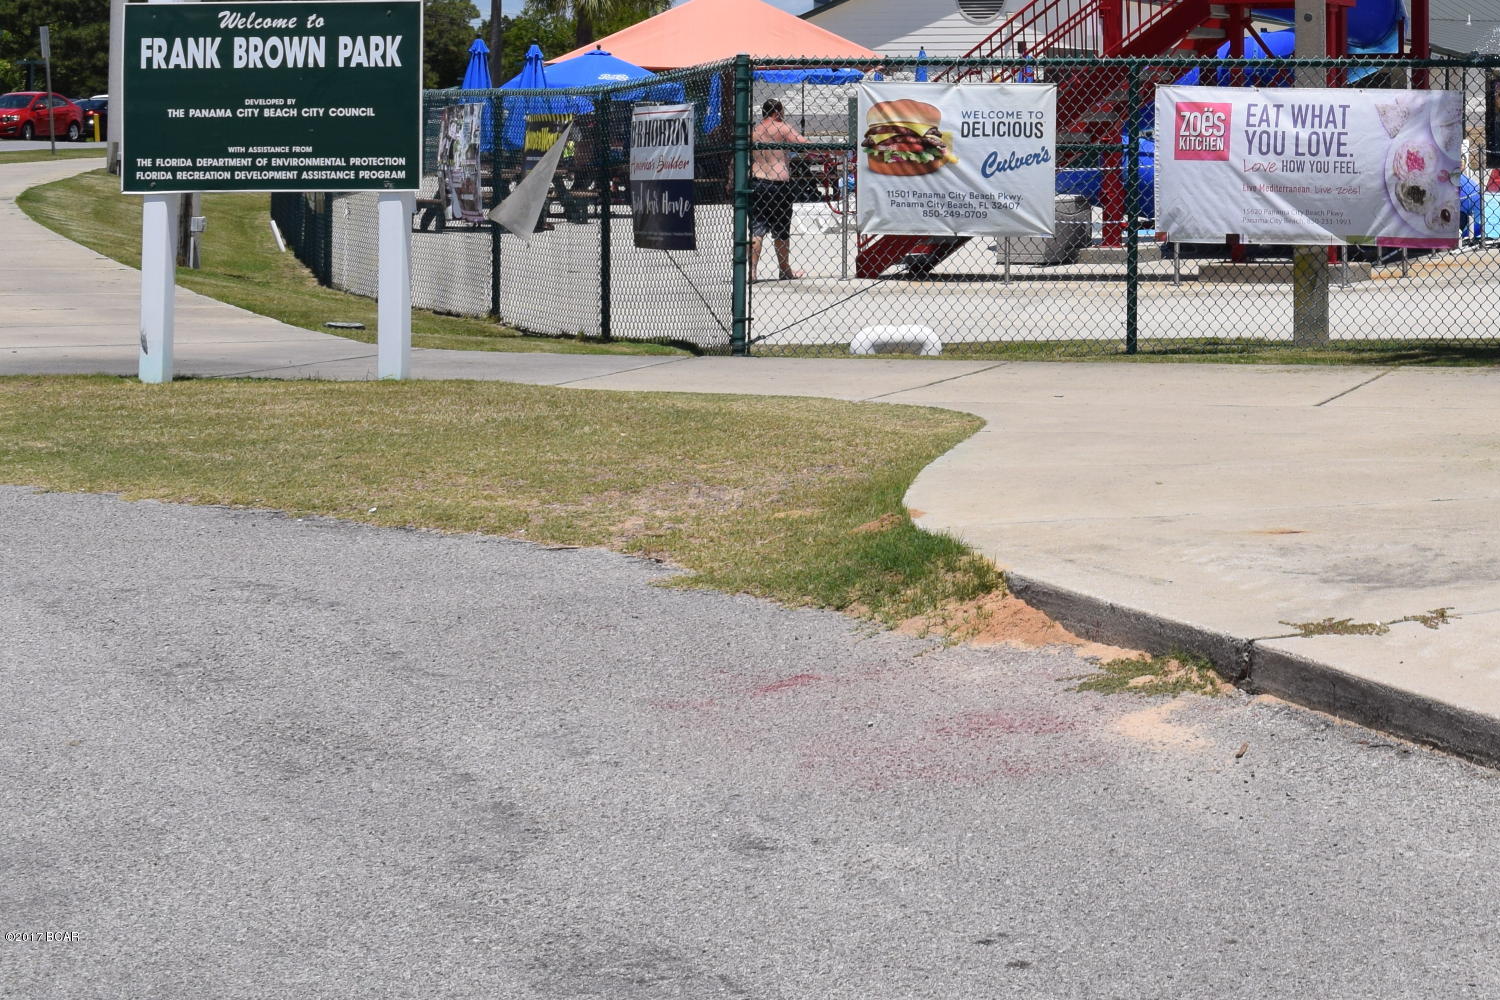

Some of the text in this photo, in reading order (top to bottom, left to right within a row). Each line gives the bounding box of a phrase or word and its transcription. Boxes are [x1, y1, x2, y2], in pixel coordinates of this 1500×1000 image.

[218, 10, 325, 29] Welcome to
[140, 35, 403, 69] FRANK BROWN PARK
[244, 98, 285, 106] DEVELOPED
[167, 107, 375, 118] THE PANAMA CITY BEACH CITY COUNCIL
[961, 110, 1044, 119] WELCOME TO
[1245, 103, 1351, 130] EAT WHAT
[961, 121, 1044, 138] DELICIOUS
[1179, 136, 1224, 151] KITCHEN
[1245, 130, 1354, 157] YOU LOVE.
[136, 157, 406, 167] THE FLORIDA DEPARTMENT OF ENVIRONMENTAL PROTECTION
[981, 146, 1051, 178] Culver's
[1242, 159, 1361, 174] Love HOW YOU FEEL.
[136, 170, 406, 180] FLORIDA RECREATION DEVELOPMENT ASSISTANCE PROGRAM
[887, 190, 1024, 201] 11501 Panama City Beach Pkwy.
[1314, 185, 1333, 194] Live
[662, 190, 692, 218] Home
[890, 200, 925, 208] Panama
[926, 200, 945, 210] City
[947, 201, 977, 210] Beach,
[991, 202, 1021, 210] 32407
[922, 210, 988, 219] 850-249-0709
